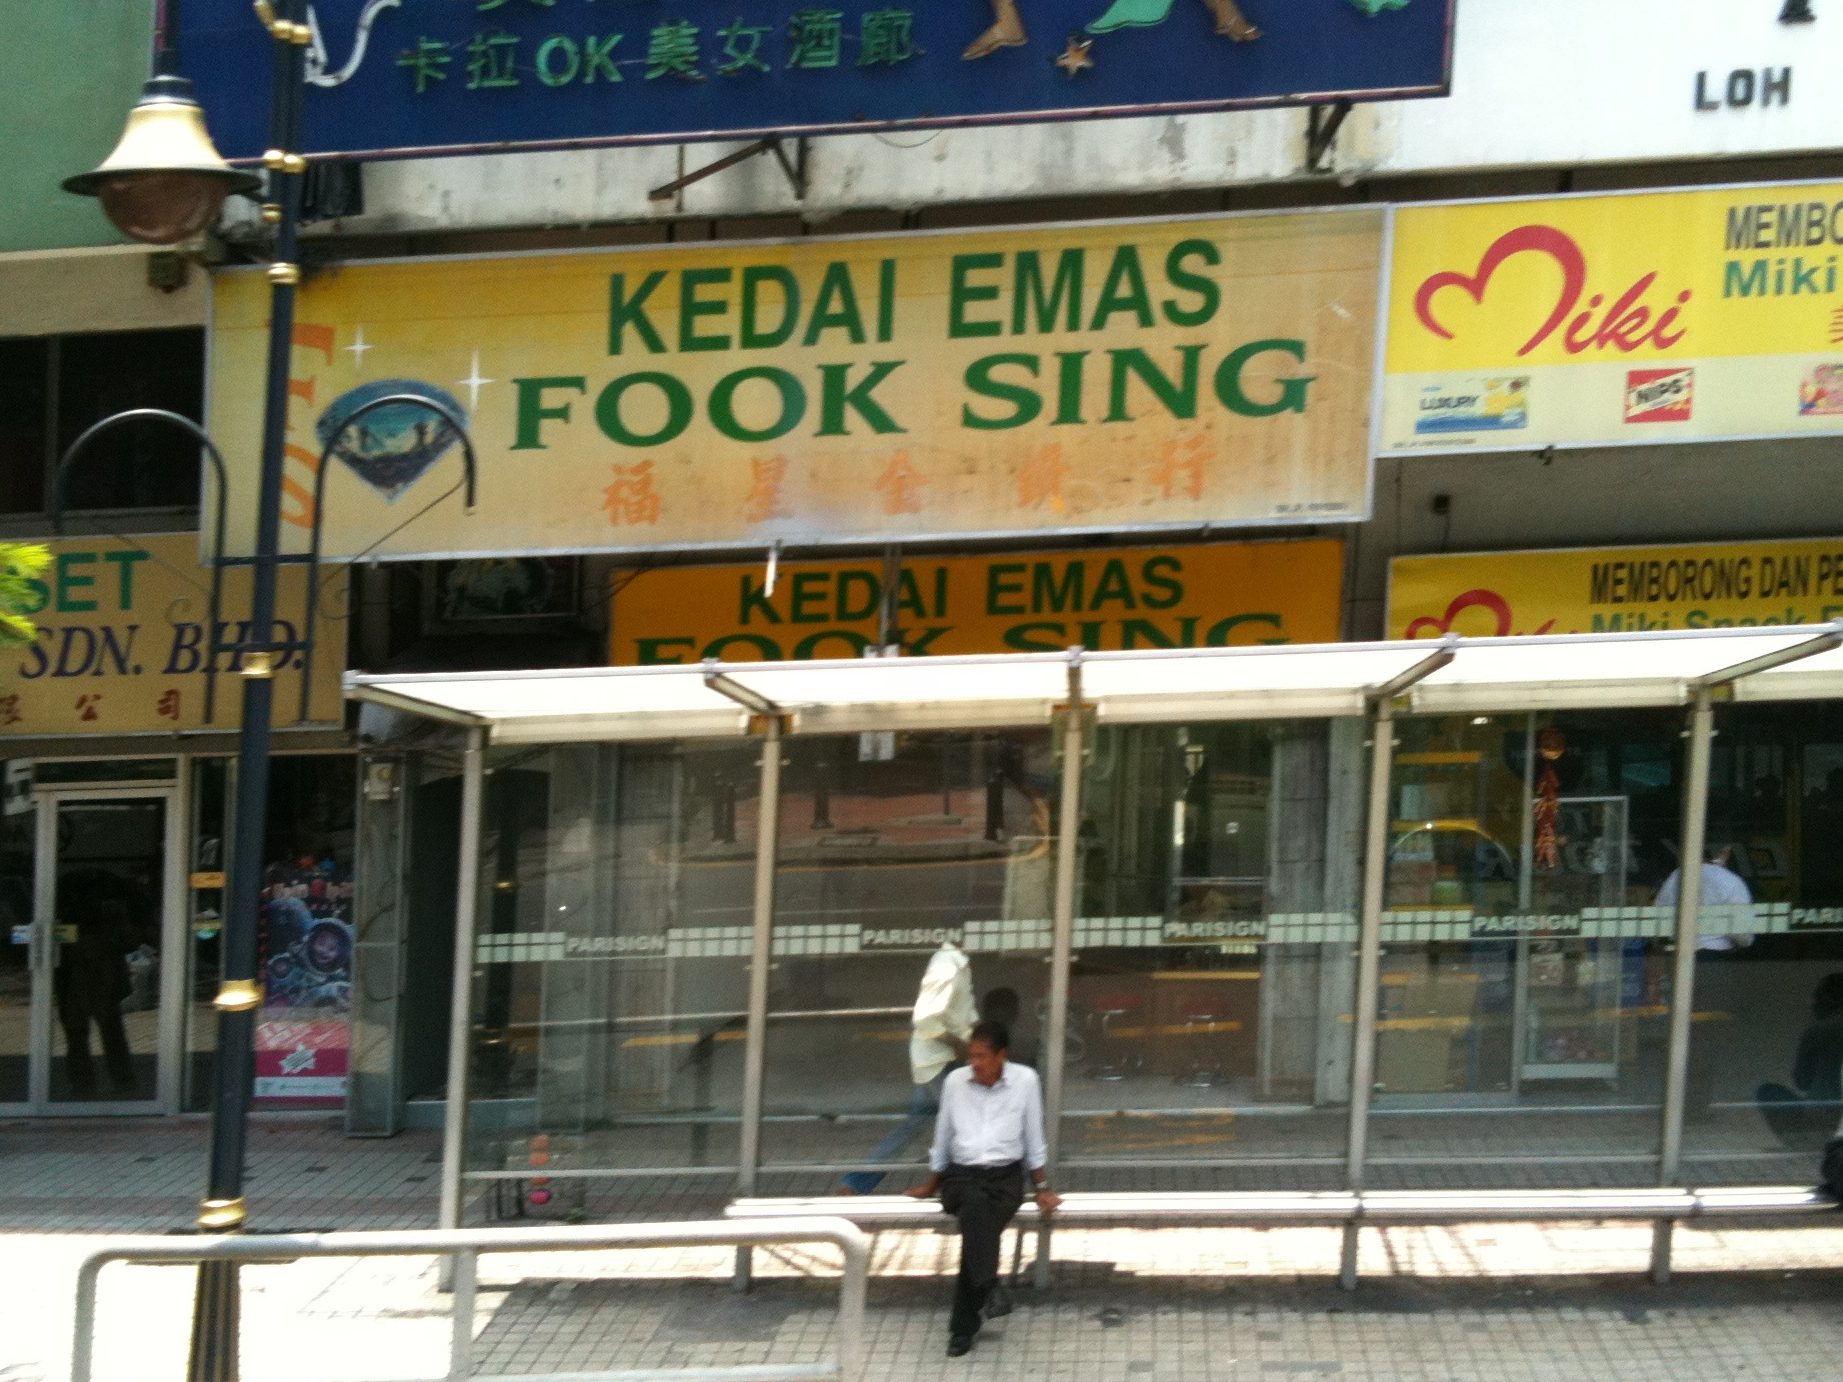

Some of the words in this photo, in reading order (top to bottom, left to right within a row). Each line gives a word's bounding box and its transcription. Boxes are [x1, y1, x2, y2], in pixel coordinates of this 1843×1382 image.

[1694, 65, 1792, 112] LOH
[608, 258, 896, 356] KEDAI
[947, 238, 1222, 340] EMAS
[1723, 255, 1837, 298] Miki
[509, 360, 908, 450] FOOK
[961, 338, 1316, 431] SING
[738, 566, 948, 626] KEDAI
[986, 555, 1184, 618] EMAS
[1591, 556, 1752, 605] MEMBORONG
[1759, 555, 1811, 600] DAN
[19, 624, 143, 680] SDN.
[1474, 914, 1579, 931] PARISIGN
